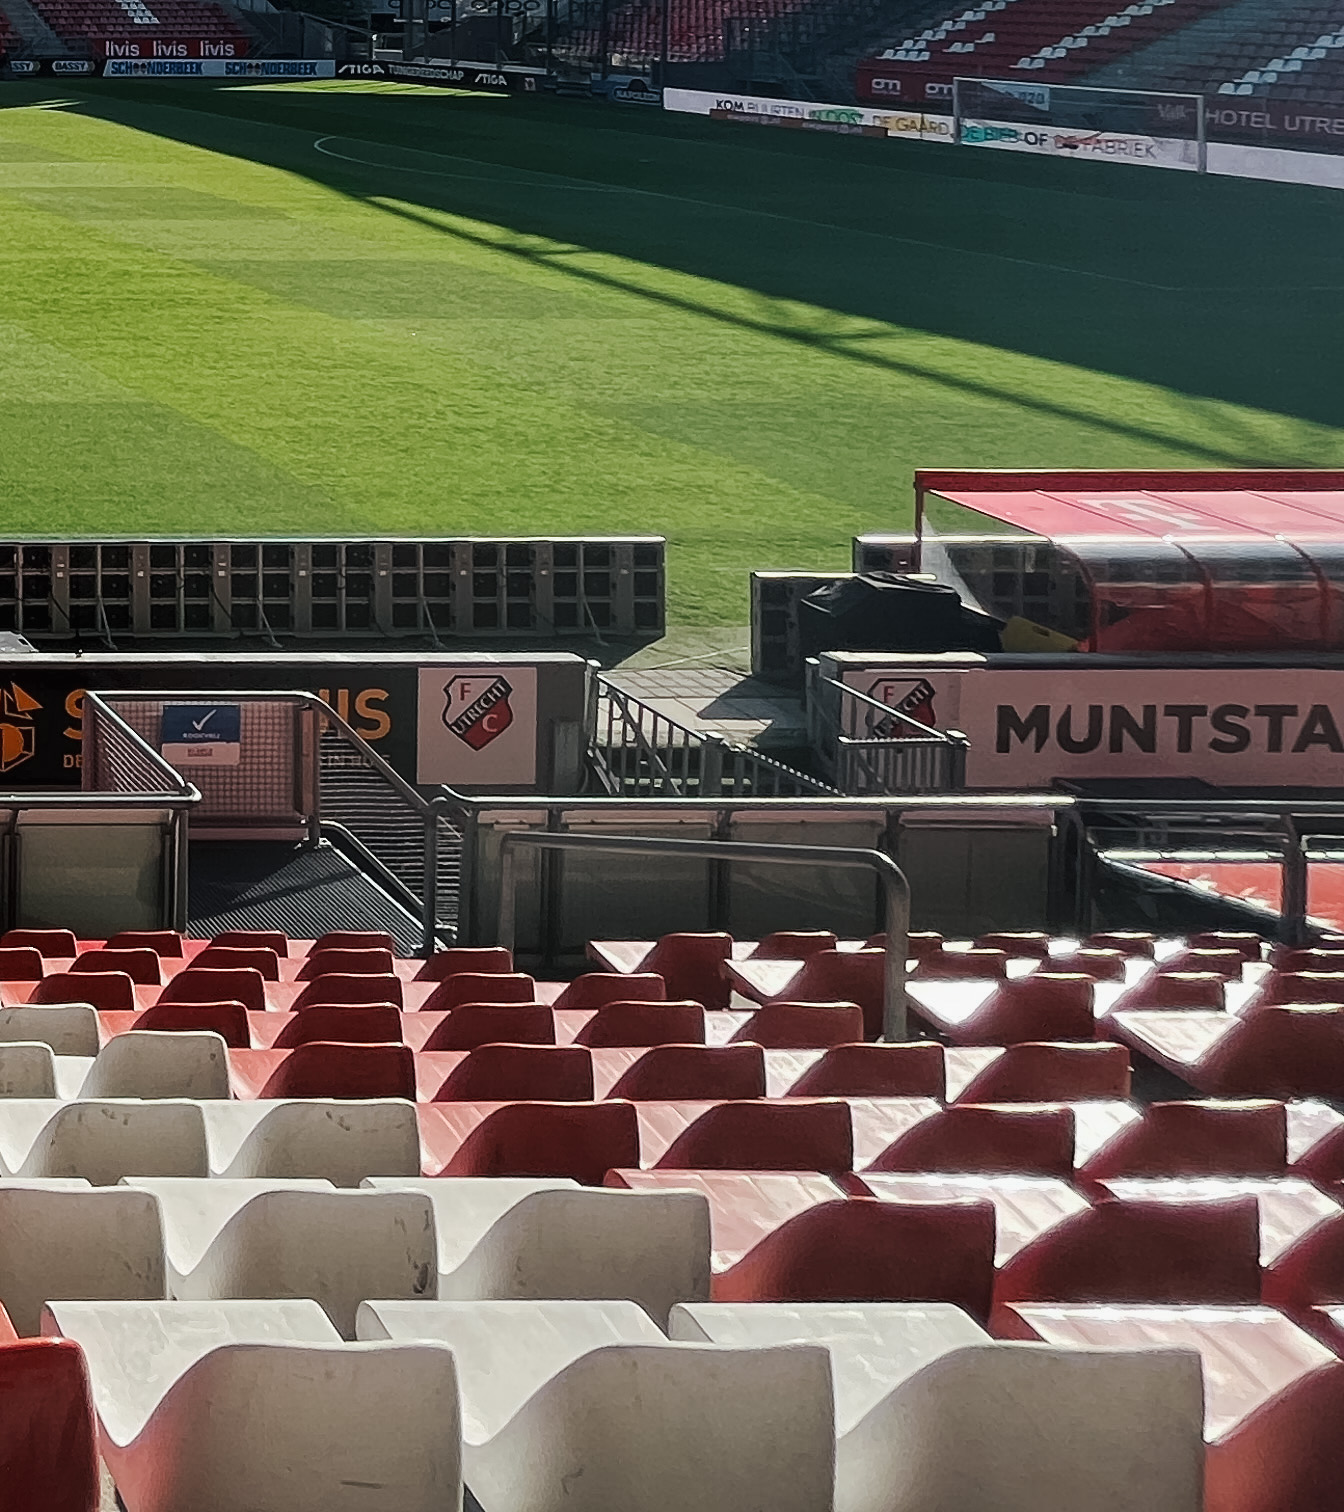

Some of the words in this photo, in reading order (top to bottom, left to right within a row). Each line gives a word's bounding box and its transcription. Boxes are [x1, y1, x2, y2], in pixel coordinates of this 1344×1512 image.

[105, 40, 140, 57] livis
[153, 40, 187, 57] livis
[200, 40, 235, 57] livis
[338, 64, 385, 75] STIGA
[474, 73, 508, 86] STIGA
[715, 99, 744, 111] KOM
[1024, 131, 1048, 146] OF
[1205, 109, 1278, 130] HOTEL
[459, 682, 472, 701] F
[451, 681, 507, 735] UTRECHT
[482, 713, 499, 733] C
[996, 704, 1344, 755] MUNTSTA
